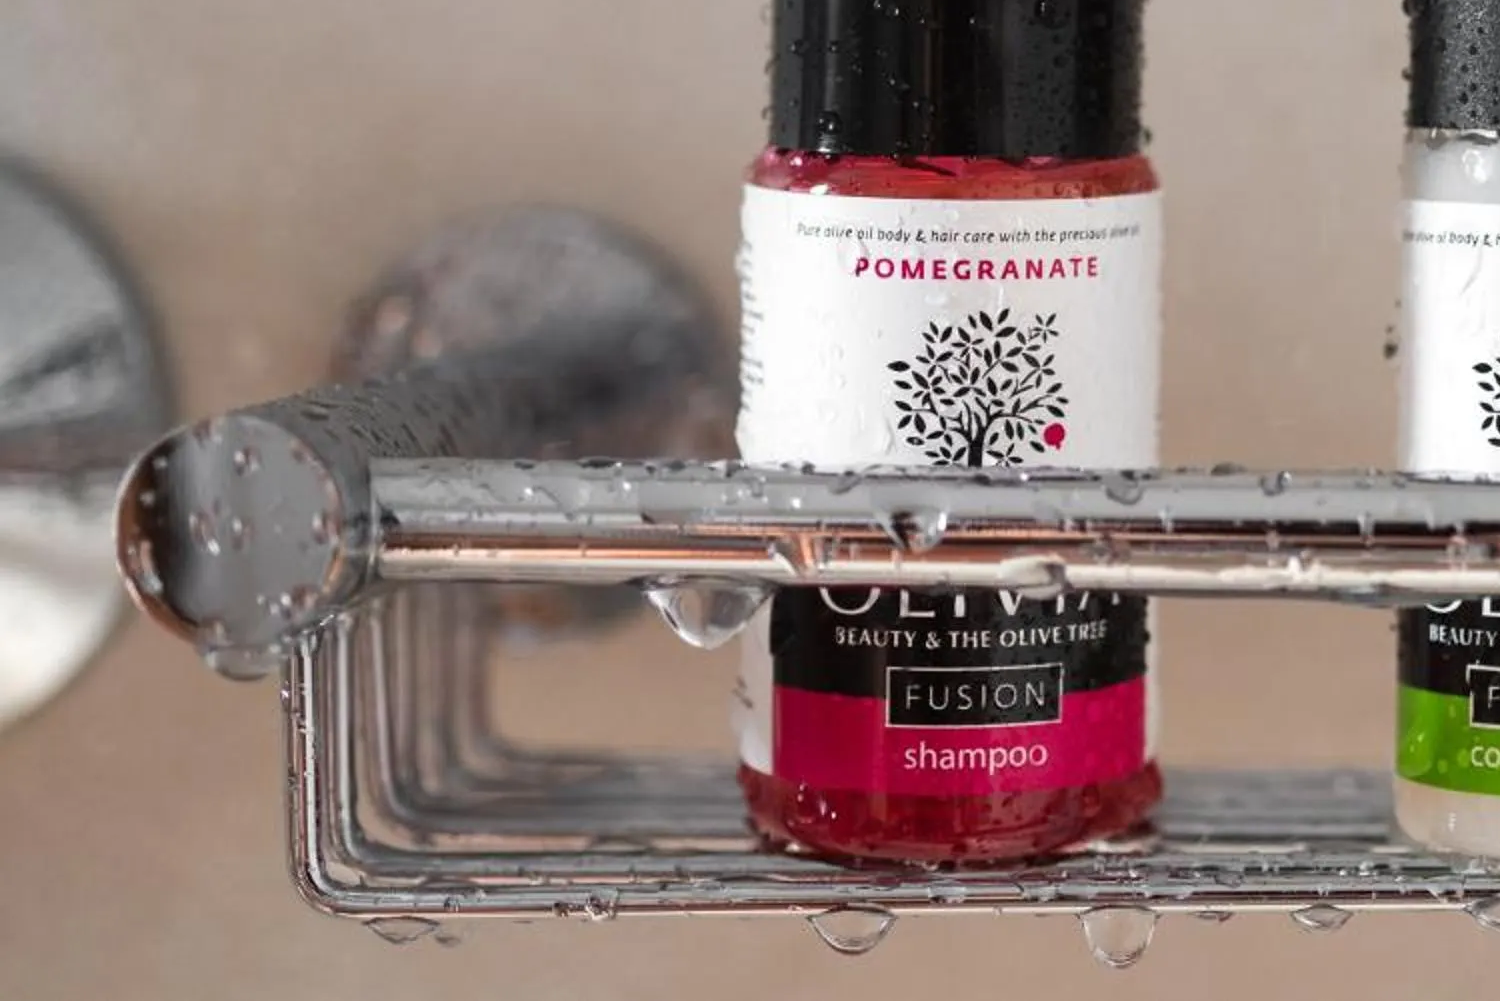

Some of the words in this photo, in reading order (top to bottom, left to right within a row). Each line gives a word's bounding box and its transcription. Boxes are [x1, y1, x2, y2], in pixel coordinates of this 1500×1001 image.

[857, 227, 873, 240] oil
[878, 229, 910, 243] body
[915, 230, 927, 244] &
[930, 229, 959, 243] hair
[963, 231, 995, 243] care
[1000, 228, 1030, 243] with
[1035, 228, 1054, 242] the
[1059, 227, 1107, 243] precious
[1449, 231, 1479, 247] body
[1483, 233, 1493, 247] &
[855, 256, 1099, 279] POMEGRANATE
[835, 626, 916, 648] BEAUTY
[925, 630, 941, 649] &
[949, 629, 991, 649] THE
[1000, 626, 1062, 648] OLIVE
[1065, 619, 1108, 642] TREE
[1429, 624, 1497, 648] BEAUTY
[906, 681, 1046, 710] FUSION
[904, 740, 1048, 775] shampoo
